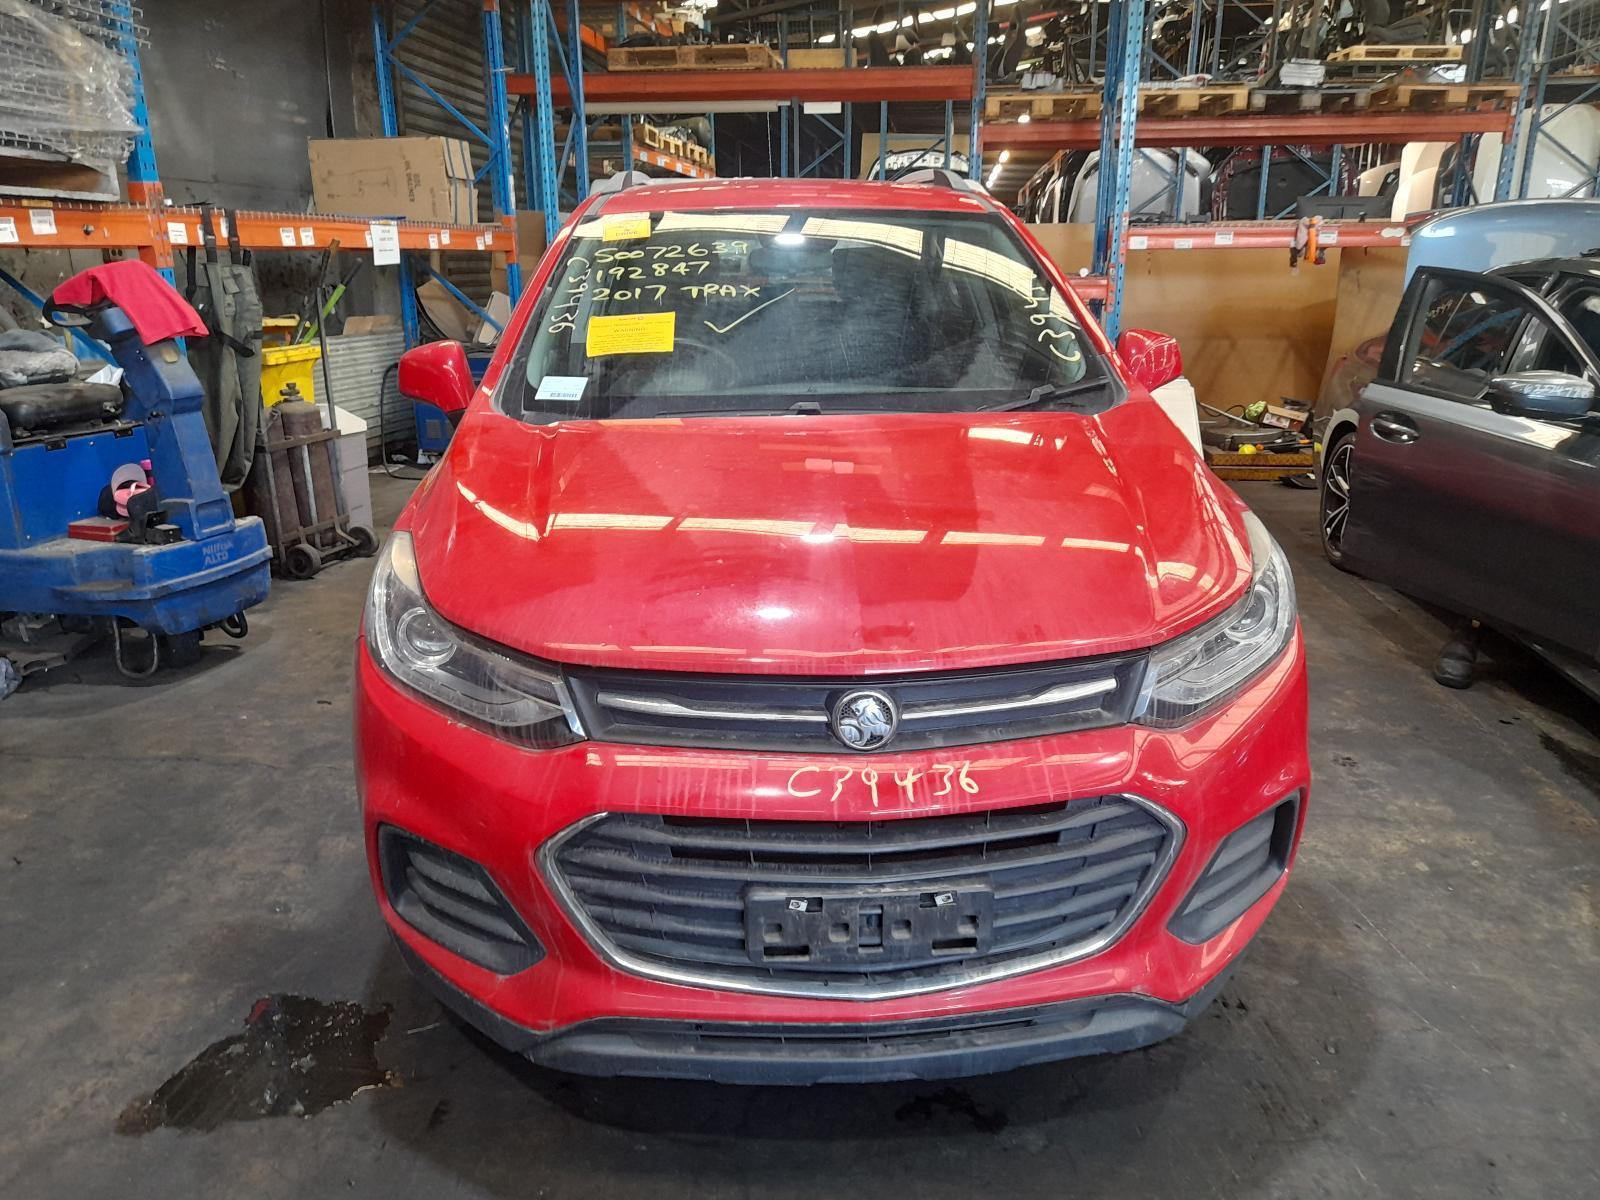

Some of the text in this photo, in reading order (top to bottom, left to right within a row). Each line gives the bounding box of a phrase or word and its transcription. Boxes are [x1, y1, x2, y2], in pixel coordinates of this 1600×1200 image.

[548, 256, 592, 334] C39436
[592, 283, 761, 303] 2017 TRAX
[787, 759, 980, 808] C39436
